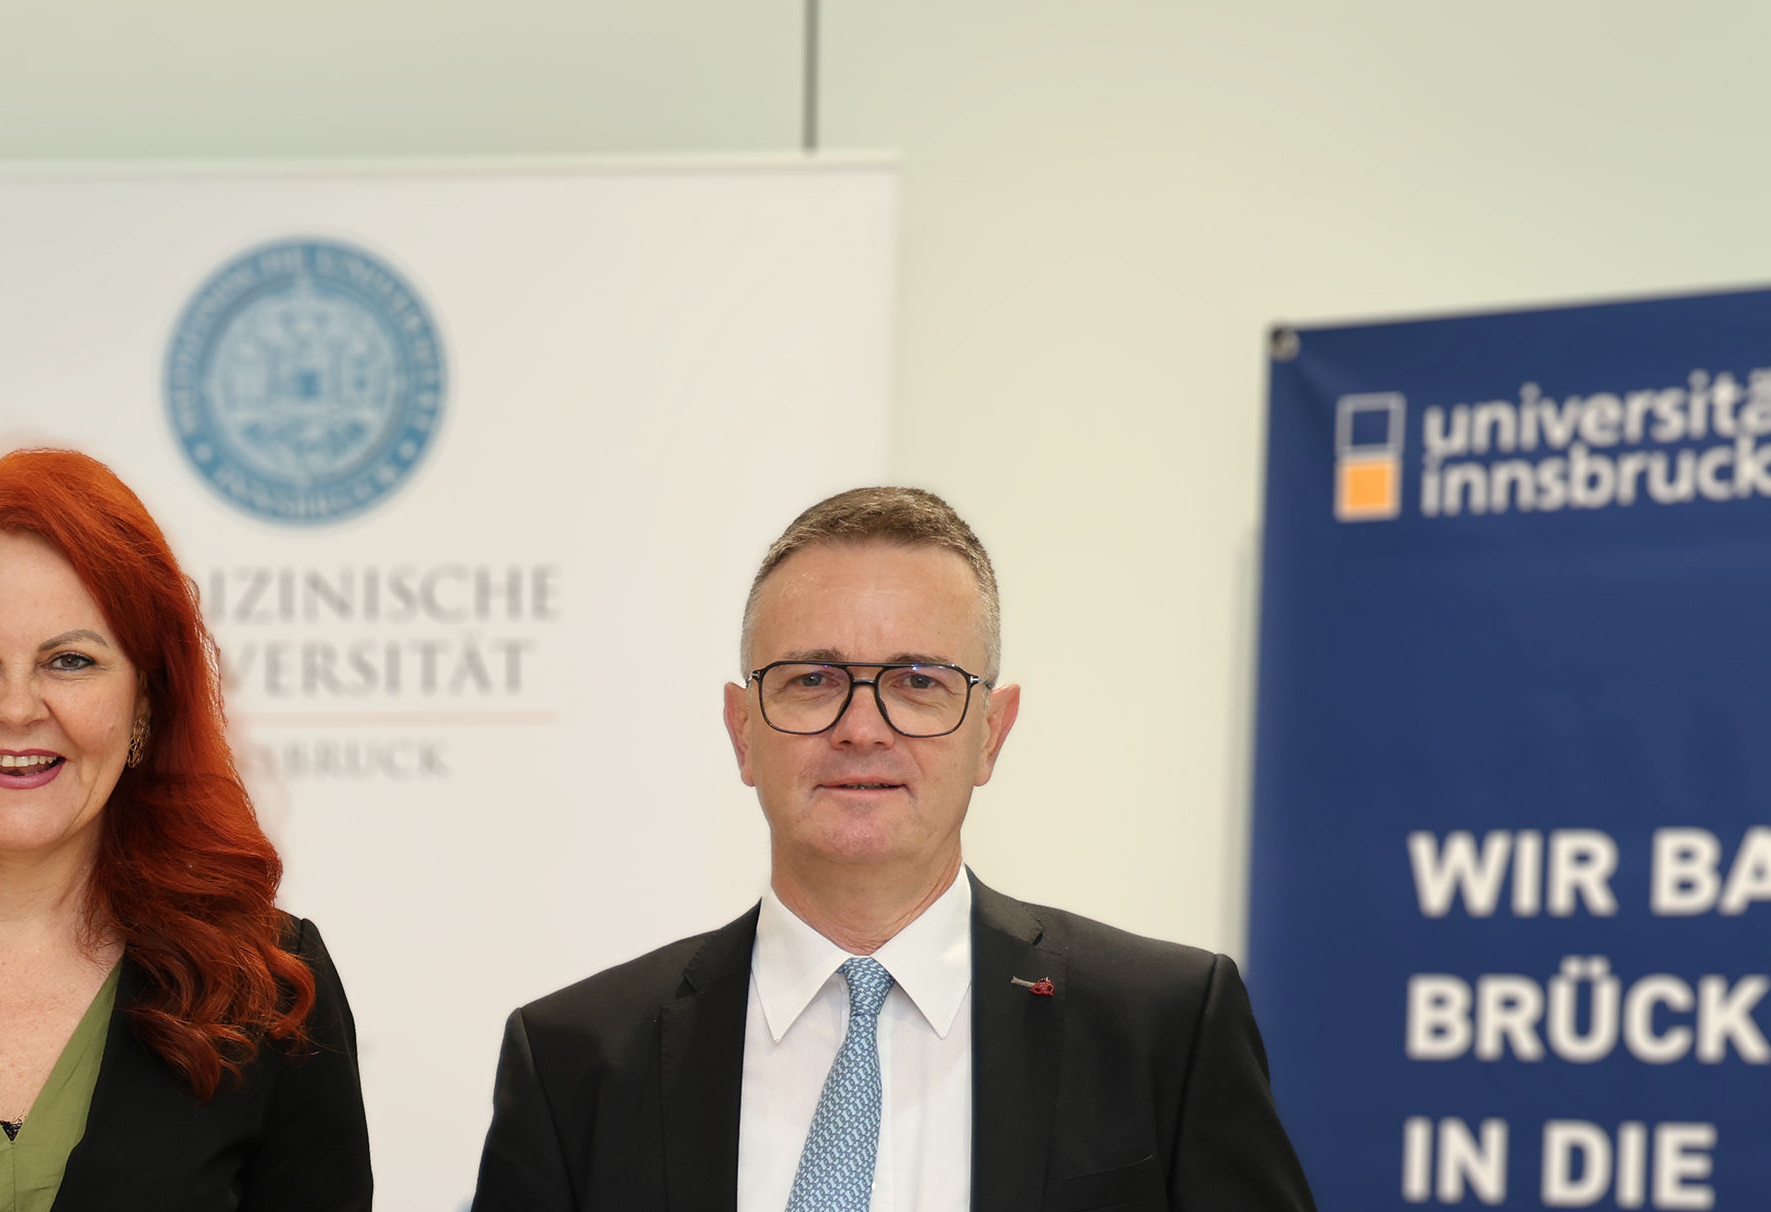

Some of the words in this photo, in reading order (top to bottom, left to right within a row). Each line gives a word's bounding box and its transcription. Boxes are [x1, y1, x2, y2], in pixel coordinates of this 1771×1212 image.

[1421, 434, 1771, 517] innsbruck
[206, 564, 562, 626] IZINISCHE
[1406, 829, 1619, 918] WIR
[1650, 825, 1771, 917] BA
[1405, 954, 1771, 1064] BRÜCK
[1401, 1117, 1509, 1206] IN
[1540, 1118, 1718, 1211] DIE
